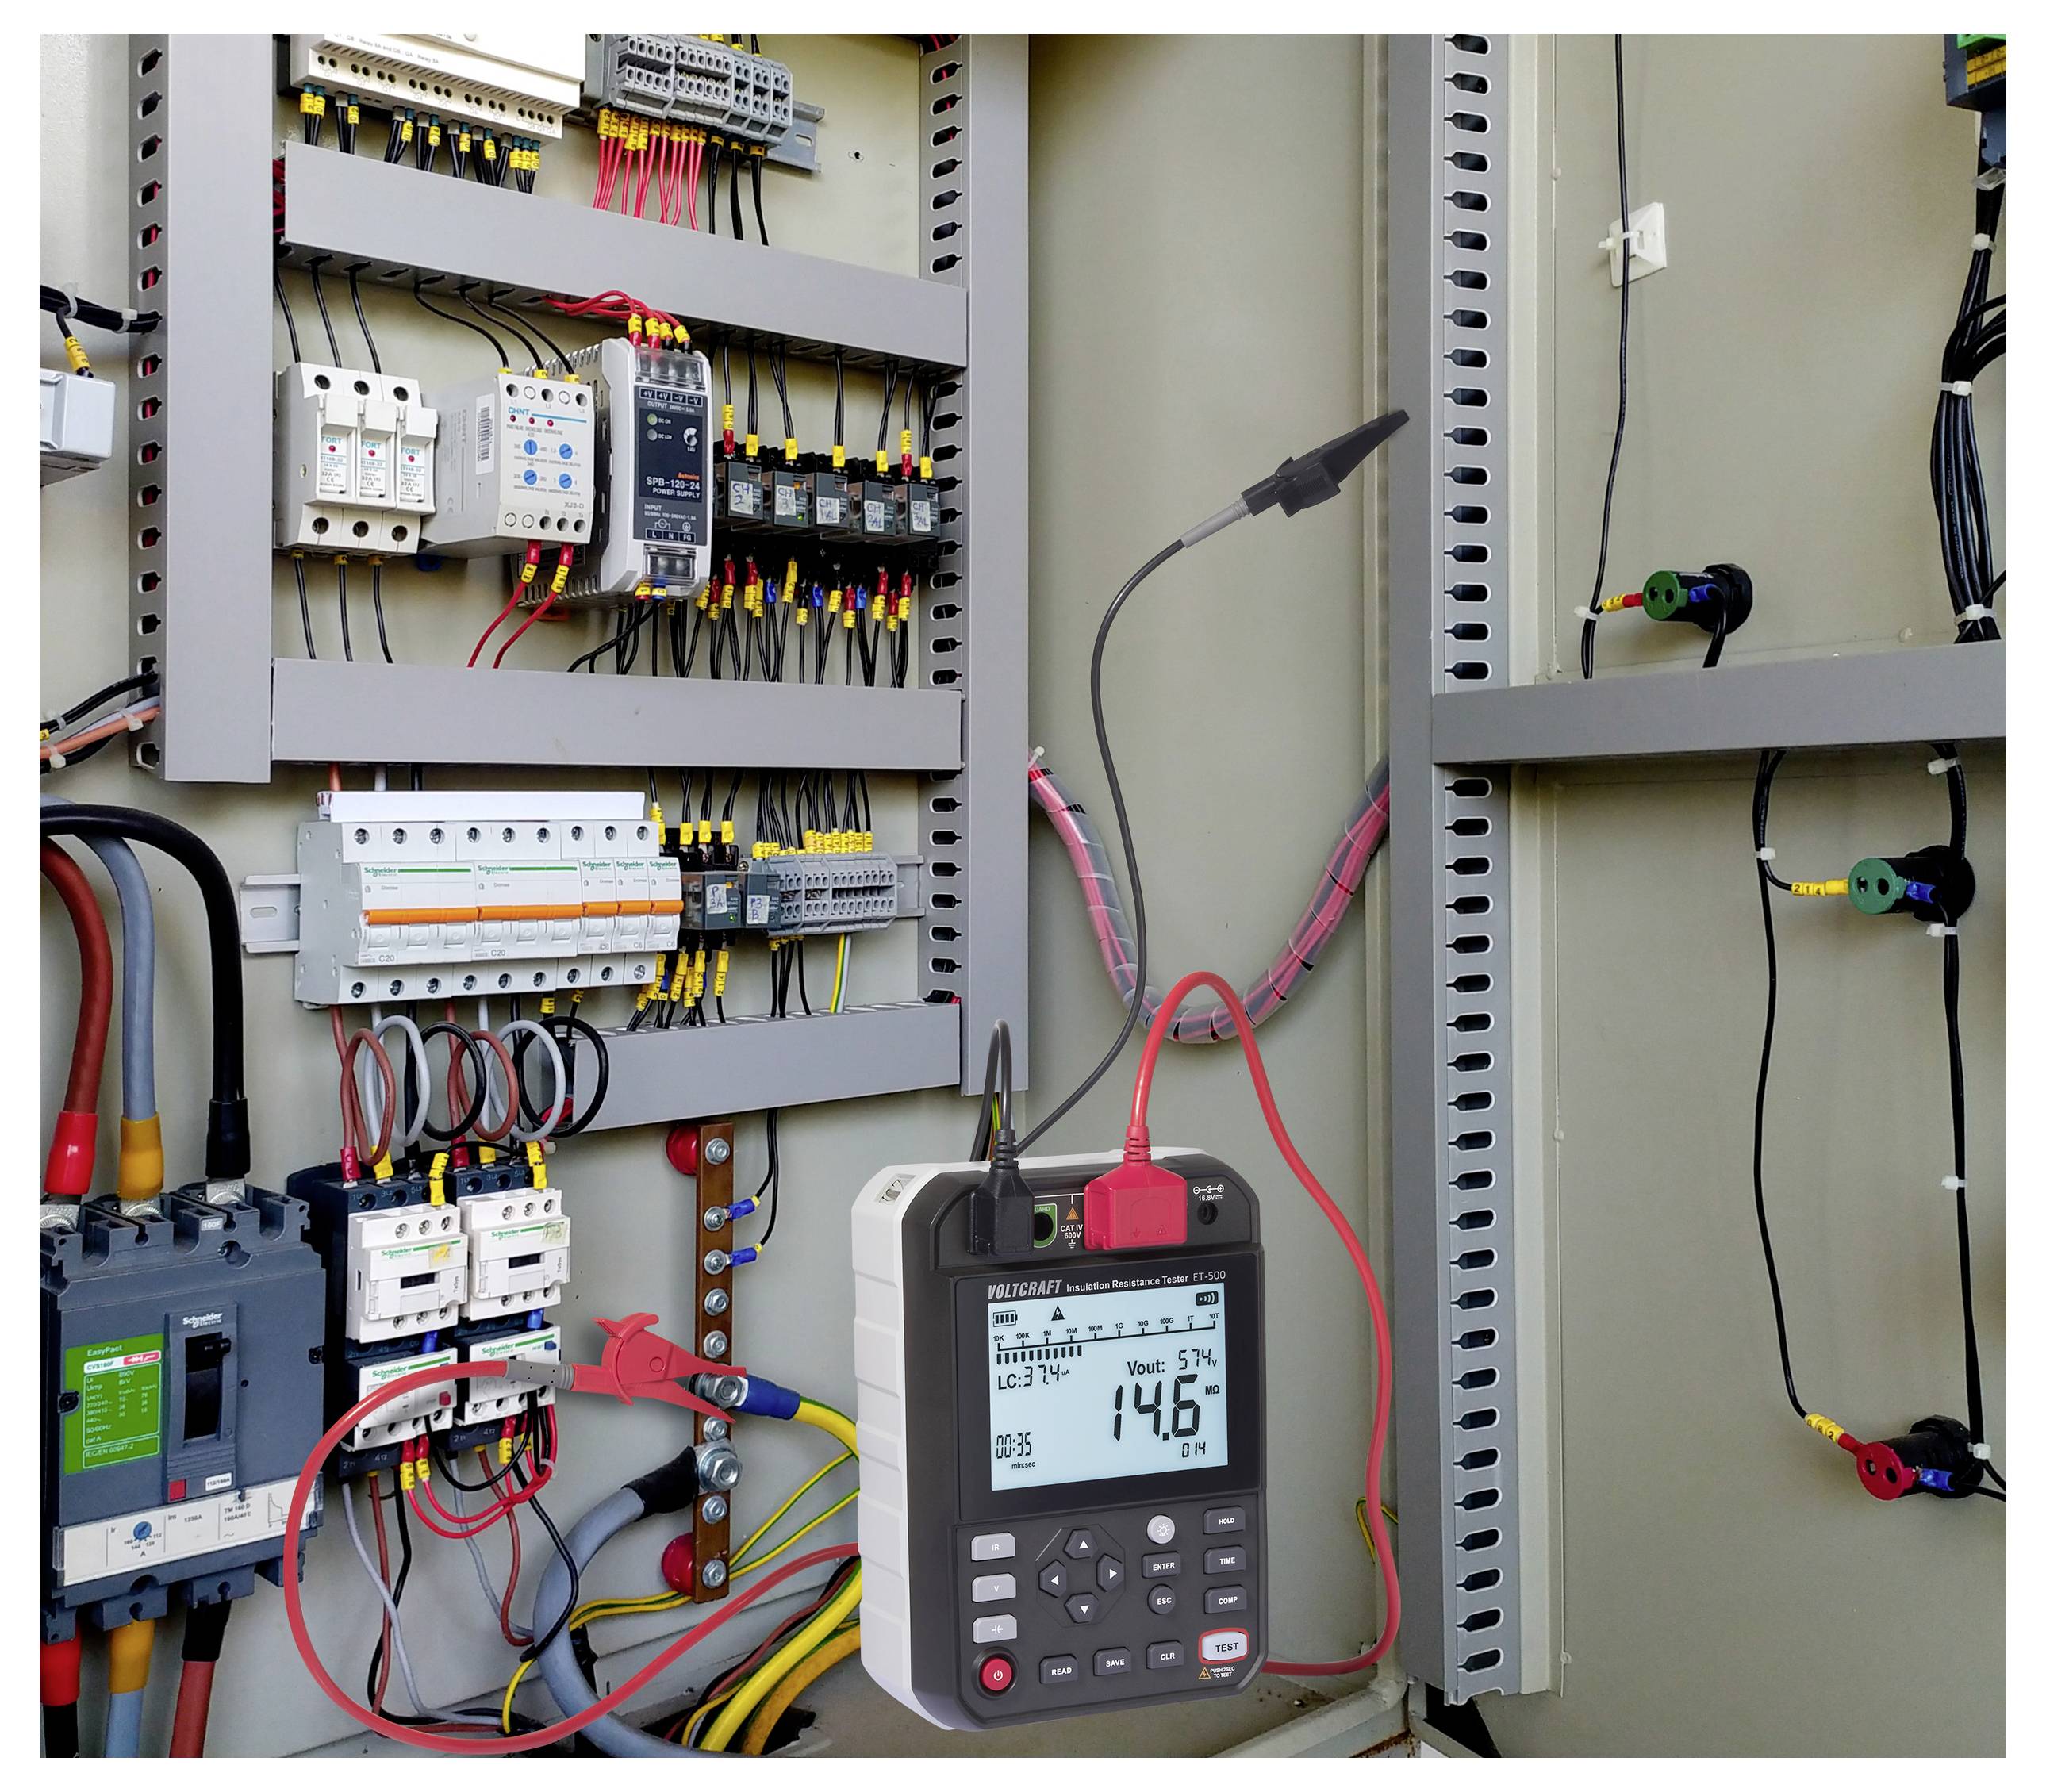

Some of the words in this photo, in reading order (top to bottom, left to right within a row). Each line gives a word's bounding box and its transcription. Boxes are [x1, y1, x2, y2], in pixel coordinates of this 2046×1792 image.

[646, 476, 701, 490] SPB-120-24
[732, 483, 750, 494] CH
[653, 487, 675, 496] POWER
[676, 490, 701, 499] SUPPLY
[778, 488, 792, 497] CH
[735, 494, 744, 505] 2
[819, 498, 832, 508] CH
[866, 502, 881, 513] CH
[912, 502, 924, 511] CH
[364, 866, 397, 877] Schneider
[478, 865, 509, 875] Schneider
[582, 861, 611, 871] Schneider
[616, 861, 644, 871] Schneider
[650, 861, 677, 871] Schneider
[1794, 884, 1821, 895] 214
[752, 909, 759, 920] B
[378, 954, 395, 963] C20
[491, 1230, 520, 1241] Schneider
[381, 1248, 413, 1259] Schneider
[988, 1279, 1063, 1300] VOLTCRAFT
[1066, 1281, 1111, 1293] Insulation
[1111, 1276, 1161, 1288] Resistance
[1161, 1275, 1189, 1284] Tester
[1192, 1270, 1226, 1282] ET-500
[182, 1313, 222, 1329] Schneider
[87, 1345, 122, 1356] EasyPact
[482, 1342, 516, 1357] Schneider
[1127, 1359, 1165, 1376] Vout:
[1179, 1348, 1211, 1371] 574
[372, 1365, 408, 1380] Schneider
[1113, 1374, 1200, 1441] 14.6
[1205, 1385, 1220, 1395] MΩ
[996, 1431, 1031, 1460] 00:35
[1181, 1441, 1207, 1458] 014
[1011, 1461, 1036, 1470] min:sec
[1219, 1556, 1236, 1565] TIME
[1153, 1562, 1176, 1571] ENTER
[1218, 1596, 1238, 1605] COMP
[1215, 1642, 1239, 1653] TEST
[1160, 1652, 1176, 1661] CLR
[1106, 1658, 1125, 1667] SAVE
[1051, 1667, 1072, 1676] READ
